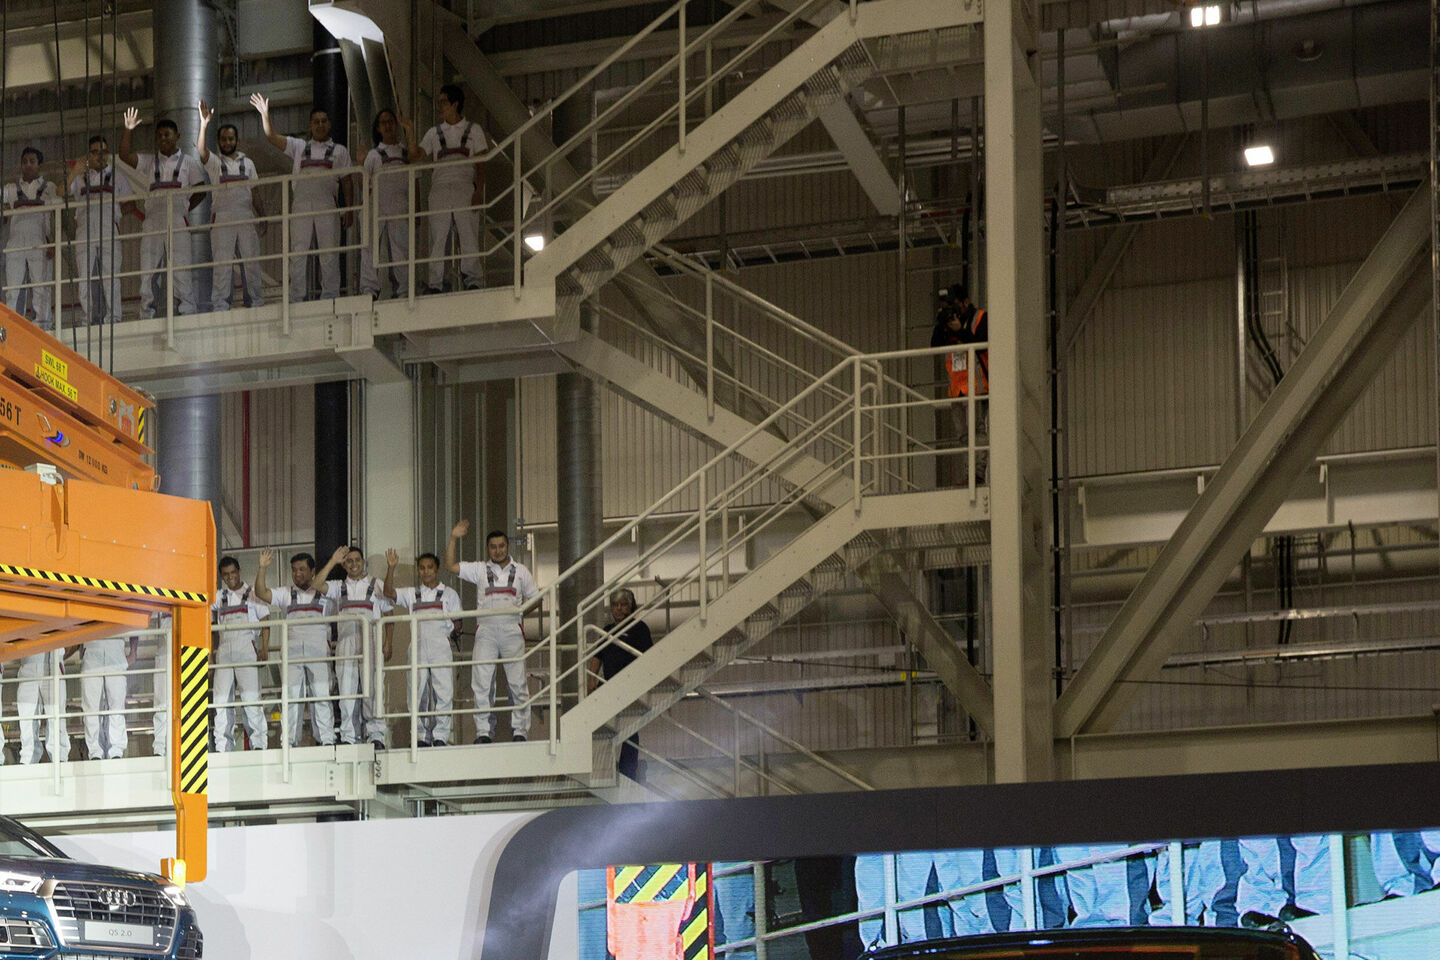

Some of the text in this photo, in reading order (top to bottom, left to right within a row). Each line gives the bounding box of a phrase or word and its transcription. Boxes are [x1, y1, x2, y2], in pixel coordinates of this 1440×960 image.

[45, 354, 55, 369] SWL
[0, 397, 12, 421] 56
[15, 405, 21, 425] T
